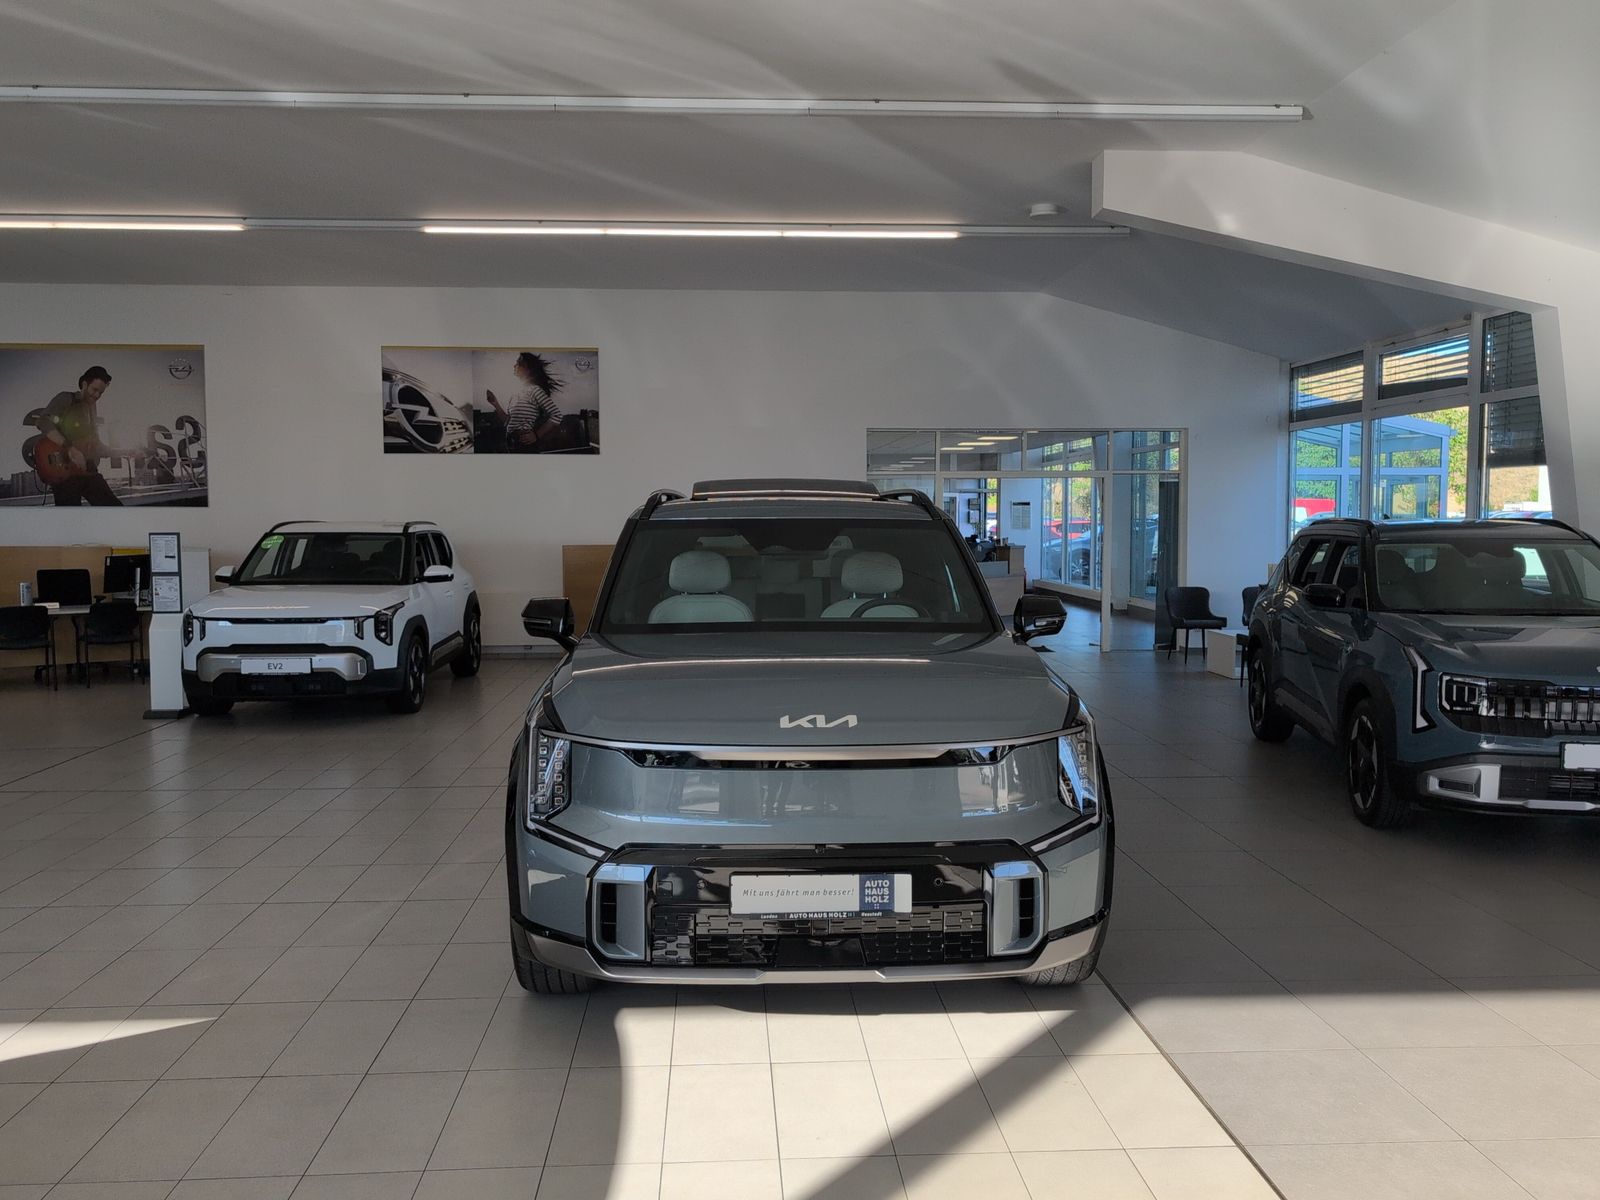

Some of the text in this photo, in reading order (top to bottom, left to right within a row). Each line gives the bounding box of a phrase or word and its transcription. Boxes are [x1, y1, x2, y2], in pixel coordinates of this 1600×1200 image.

[267, 662, 284, 670] EV2
[779, 714, 858, 728] KIA
[864, 879, 890, 887] AUTO
[742, 888, 757, 896] Mit
[759, 889, 774, 897] uns
[775, 888, 800, 898] fährt
[822, 888, 855, 896] besser!
[864, 887, 890, 895] HAUS
[864, 895, 890, 903] HOLZ
